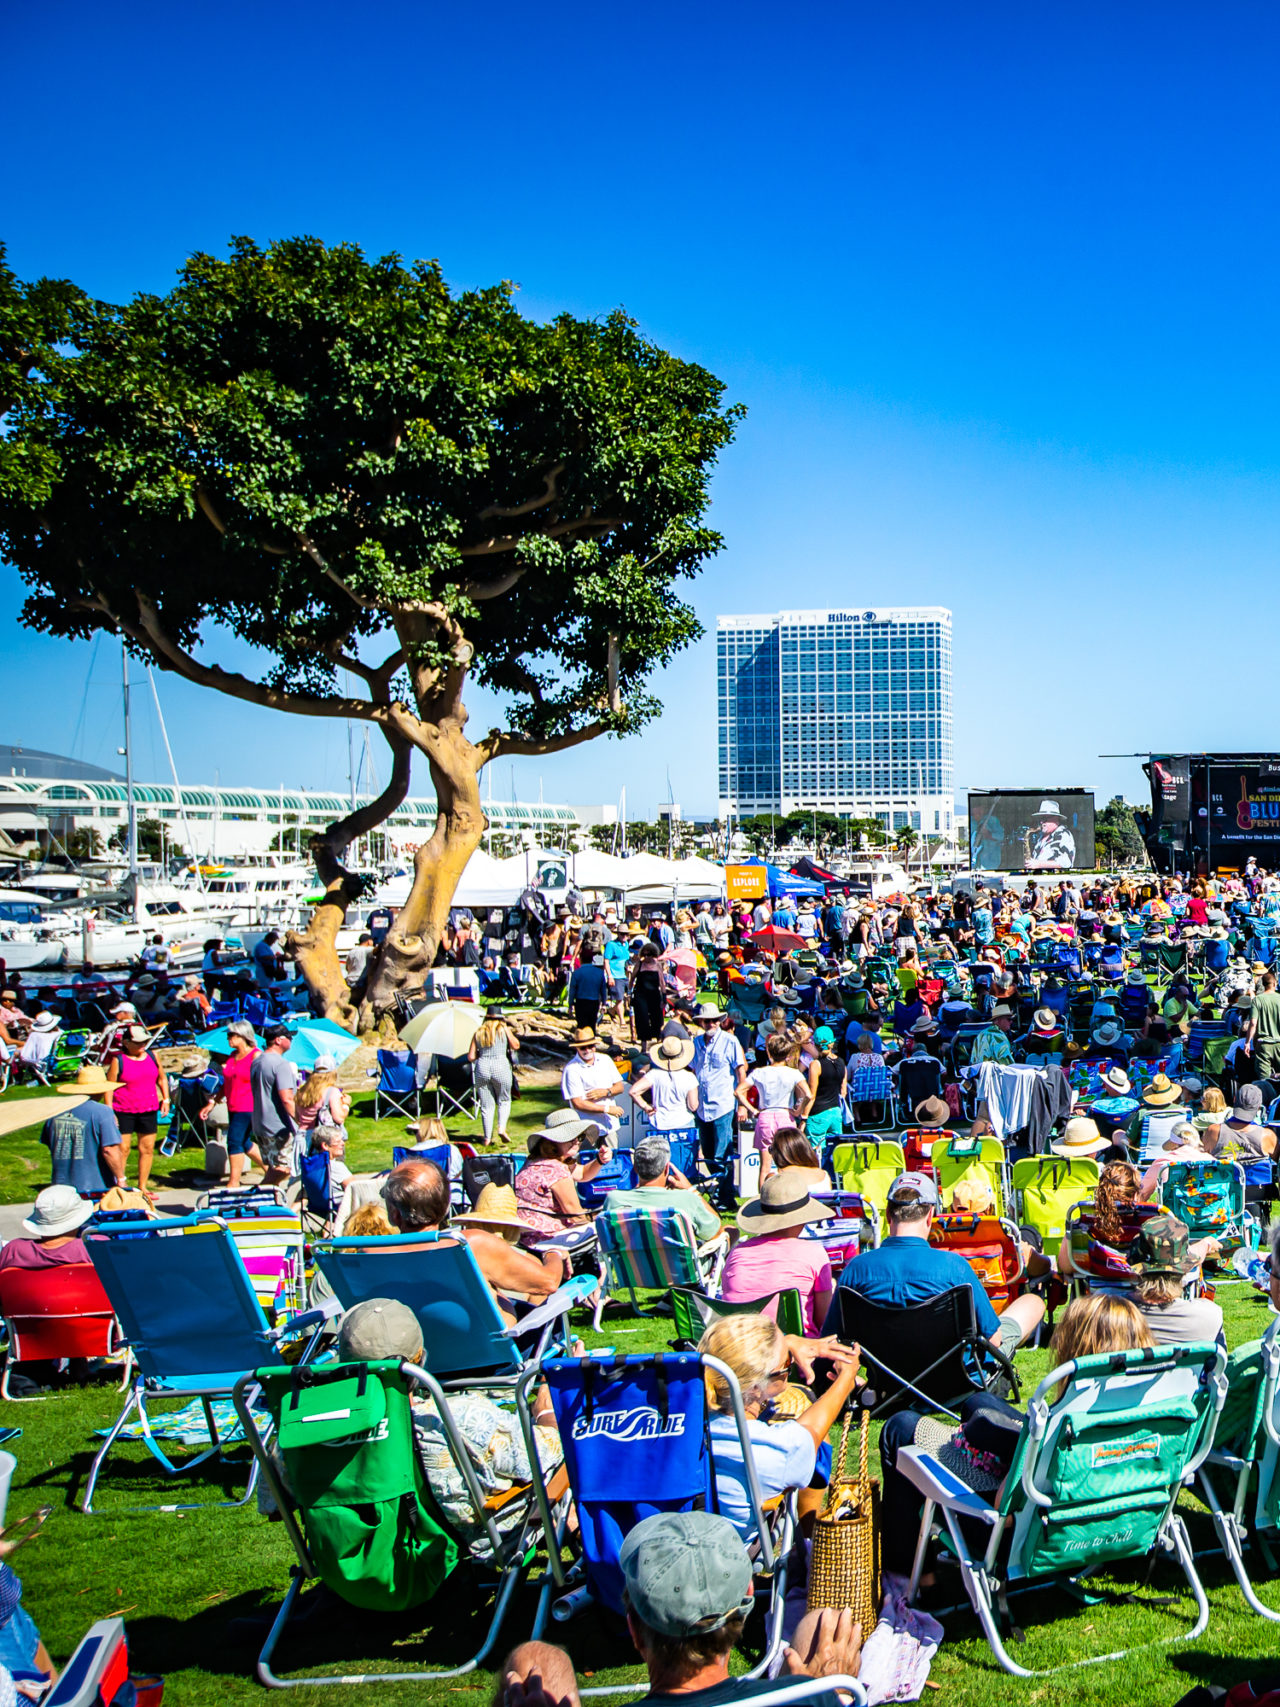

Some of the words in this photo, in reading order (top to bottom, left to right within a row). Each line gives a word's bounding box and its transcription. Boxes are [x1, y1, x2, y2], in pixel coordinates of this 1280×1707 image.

[828, 612, 860, 622] Hilton
[733, 877, 761, 887] EXPLORE
[572, 1410, 627, 1440] SURF
[1063, 1539, 1090, 1552] Time
[1092, 1535, 1104, 1547] to
[1105, 1529, 1133, 1544] Chill
